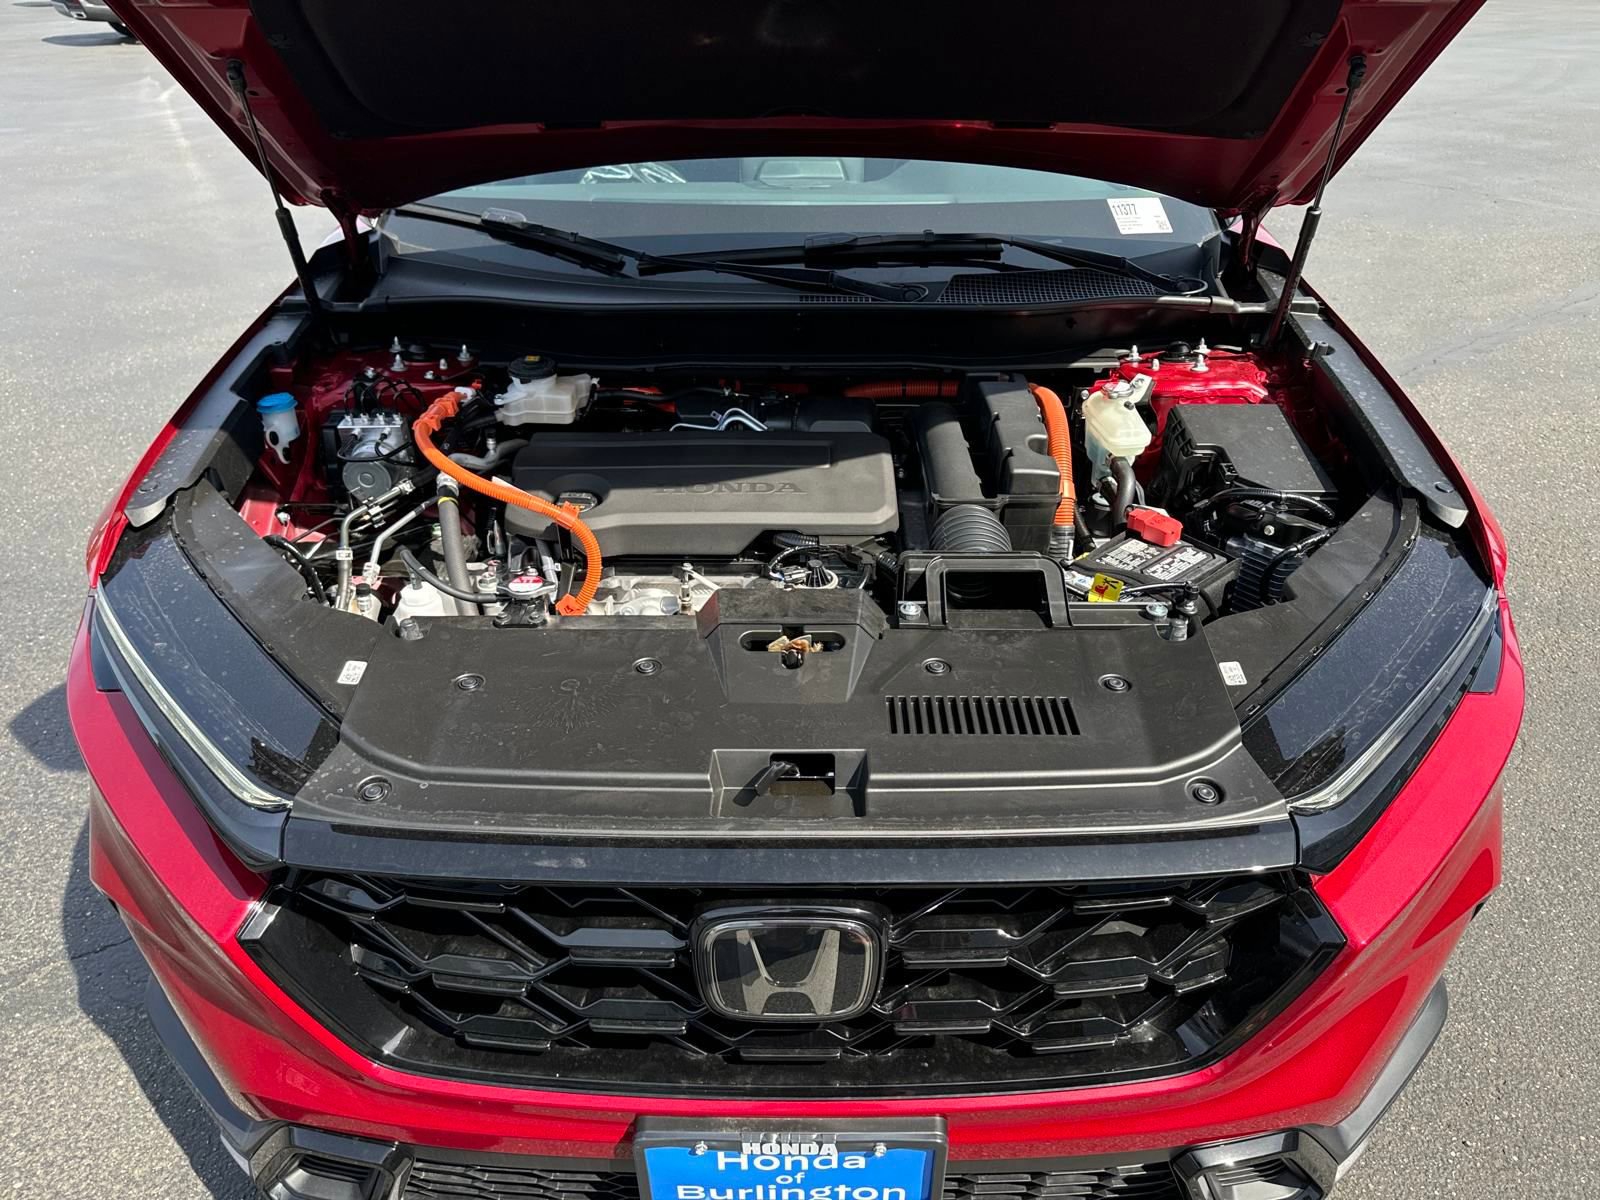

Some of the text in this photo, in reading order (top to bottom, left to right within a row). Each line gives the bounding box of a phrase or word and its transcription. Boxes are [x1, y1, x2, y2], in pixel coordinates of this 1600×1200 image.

[1112, 203, 1137, 216] 11377
[741, 1141, 838, 1155] HONDA
[717, 1152, 866, 1170] Honda
[775, 1172, 805, 1184] of
[676, 1184, 906, 1200] Burlington
